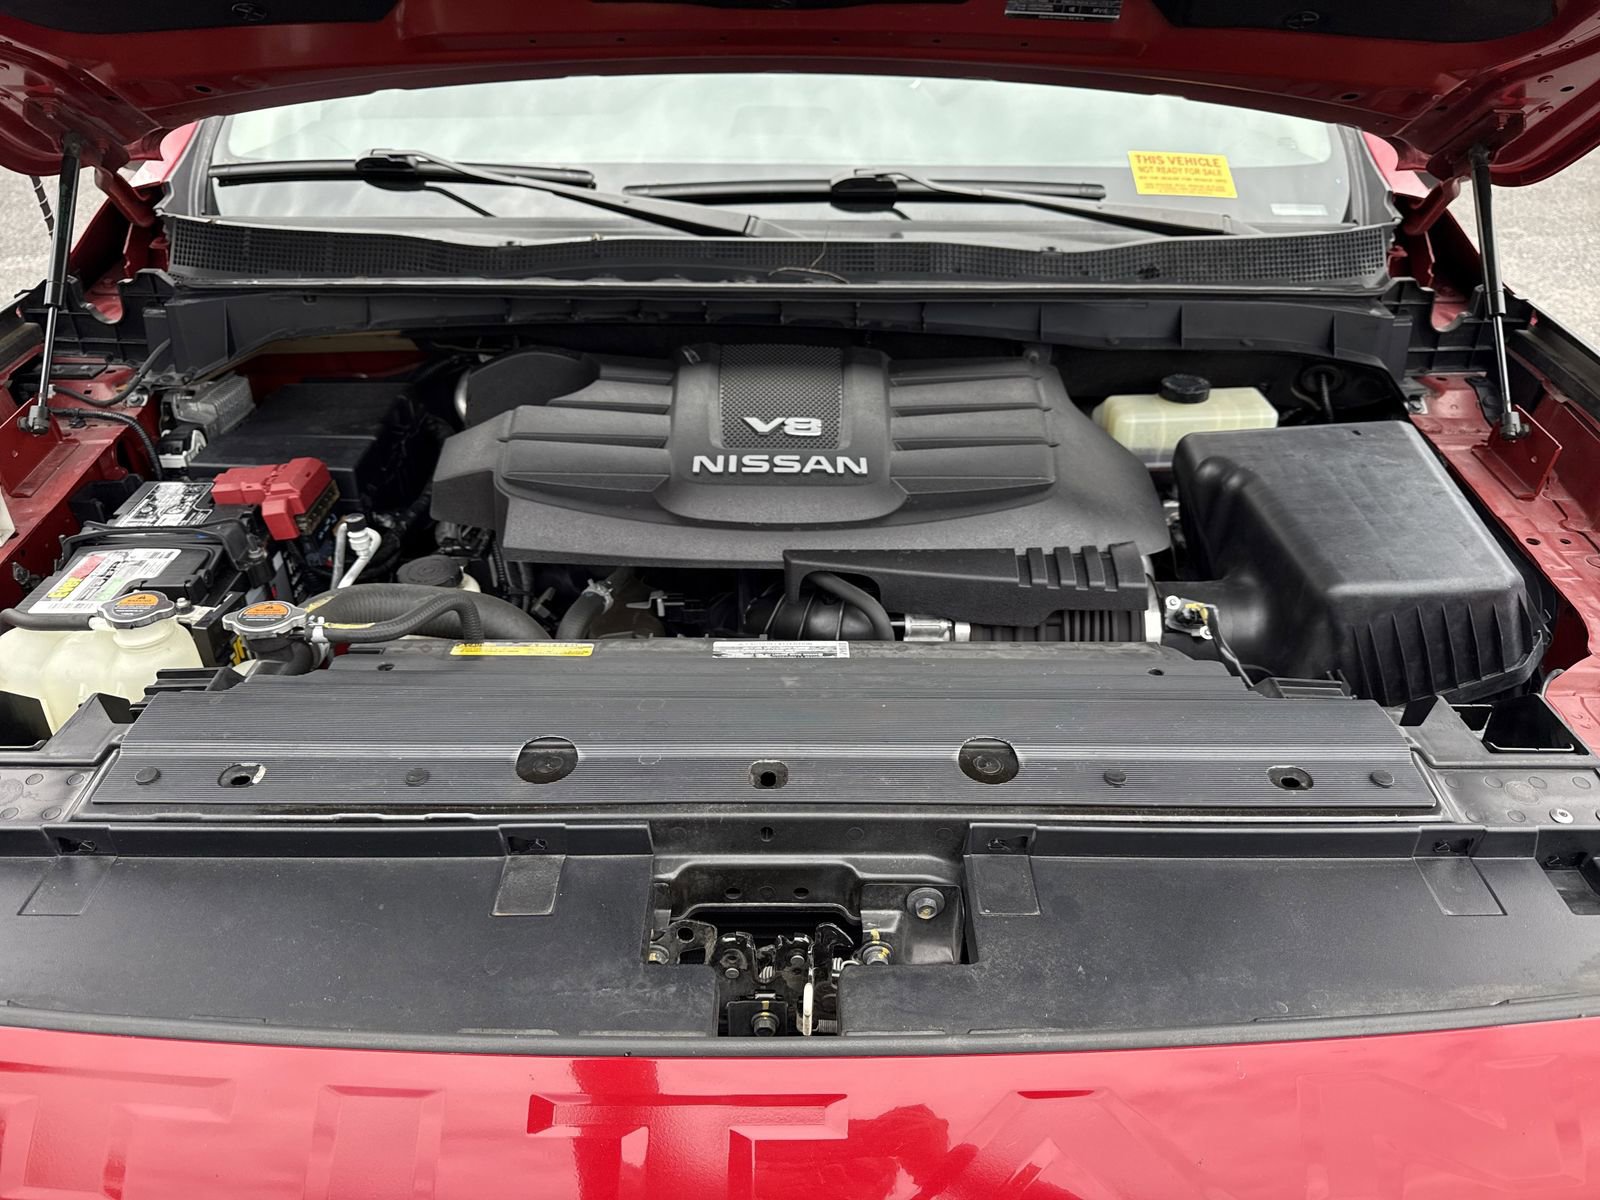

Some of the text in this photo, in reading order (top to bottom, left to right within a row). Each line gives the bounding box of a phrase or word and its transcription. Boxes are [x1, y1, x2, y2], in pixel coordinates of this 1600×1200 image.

[1135, 154, 1222, 168] THIS VEHICLE
[1137, 166, 1222, 177] NOT READY FOR SALE
[742, 416, 822, 436] V8
[692, 454, 868, 474] NISSAN
